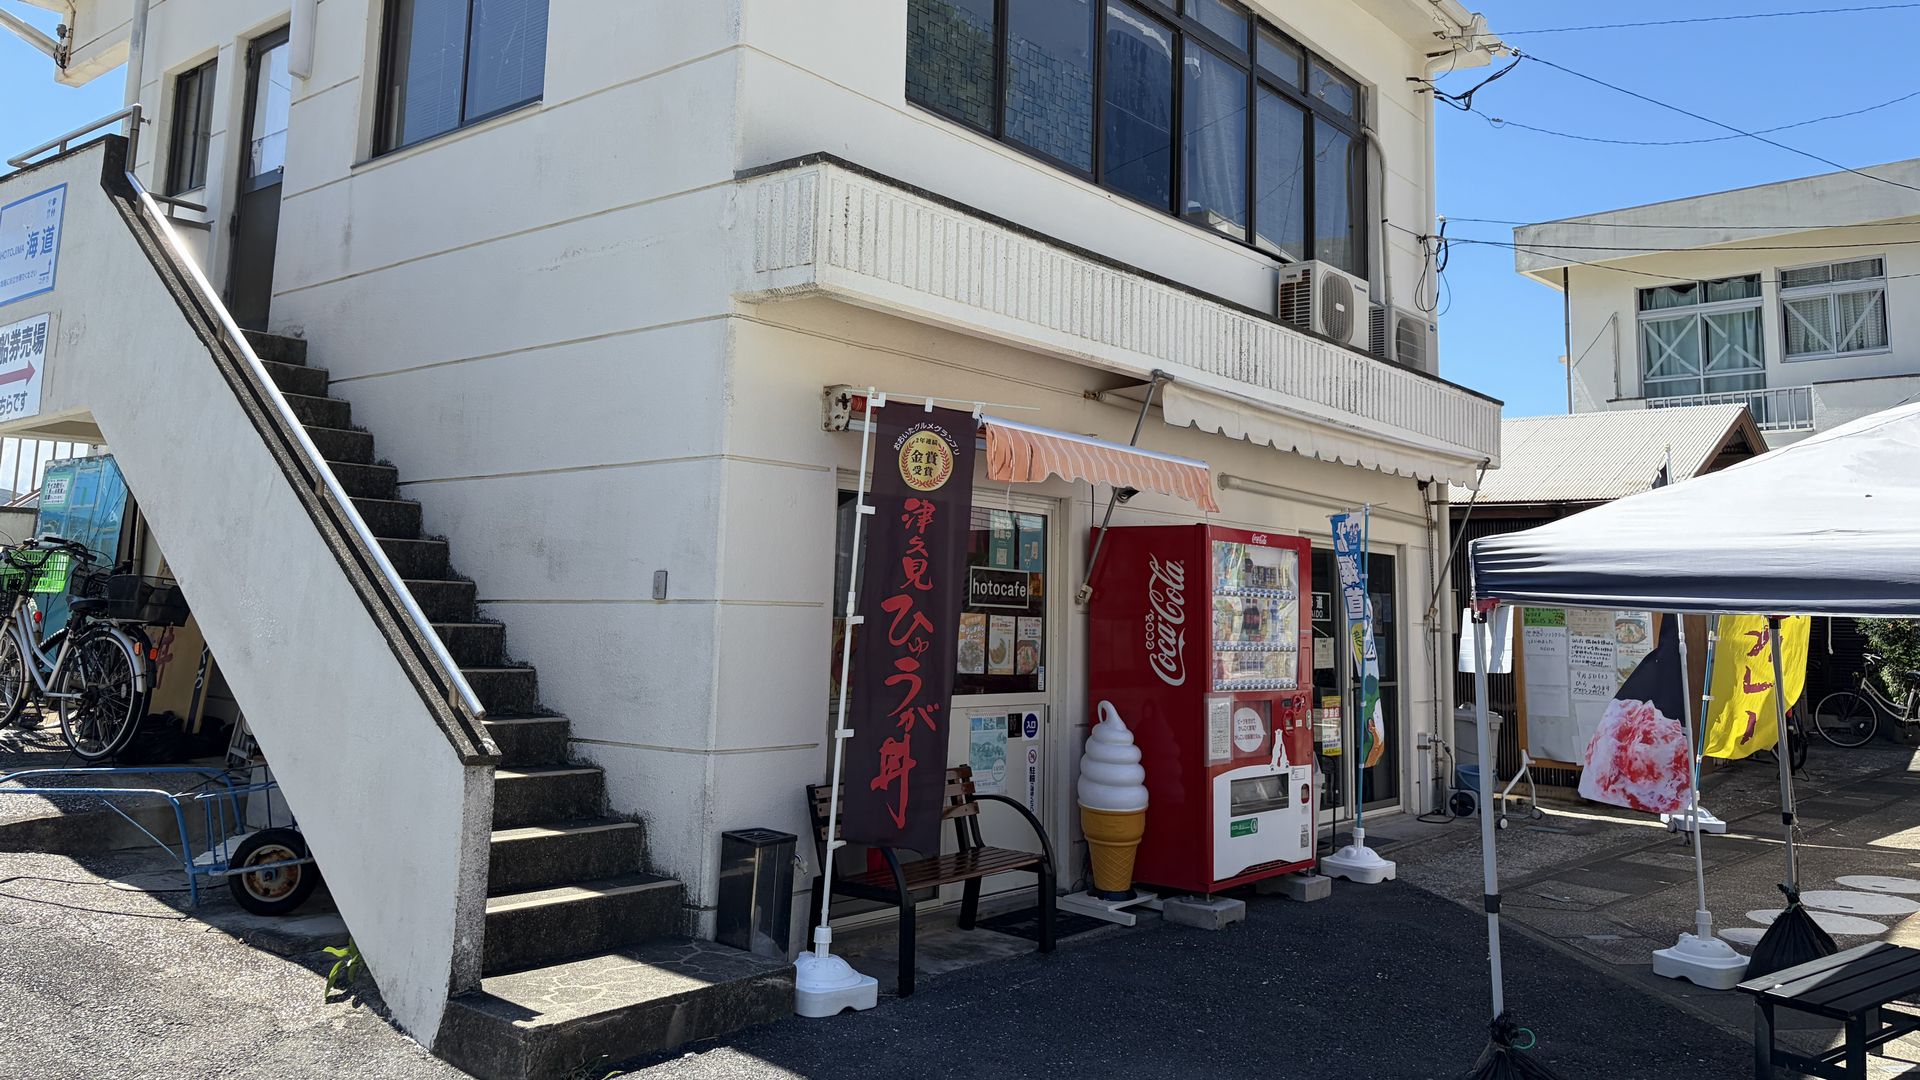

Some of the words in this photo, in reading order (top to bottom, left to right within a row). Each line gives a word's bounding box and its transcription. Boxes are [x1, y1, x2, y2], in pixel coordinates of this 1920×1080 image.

[25, 223, 55, 260] 海道
[911, 449, 938, 466] 金賞
[912, 465, 934, 478] 受賞
[972, 577, 1027, 598] hotocafe
[1149, 552, 1186, 686] Coca-Cola
